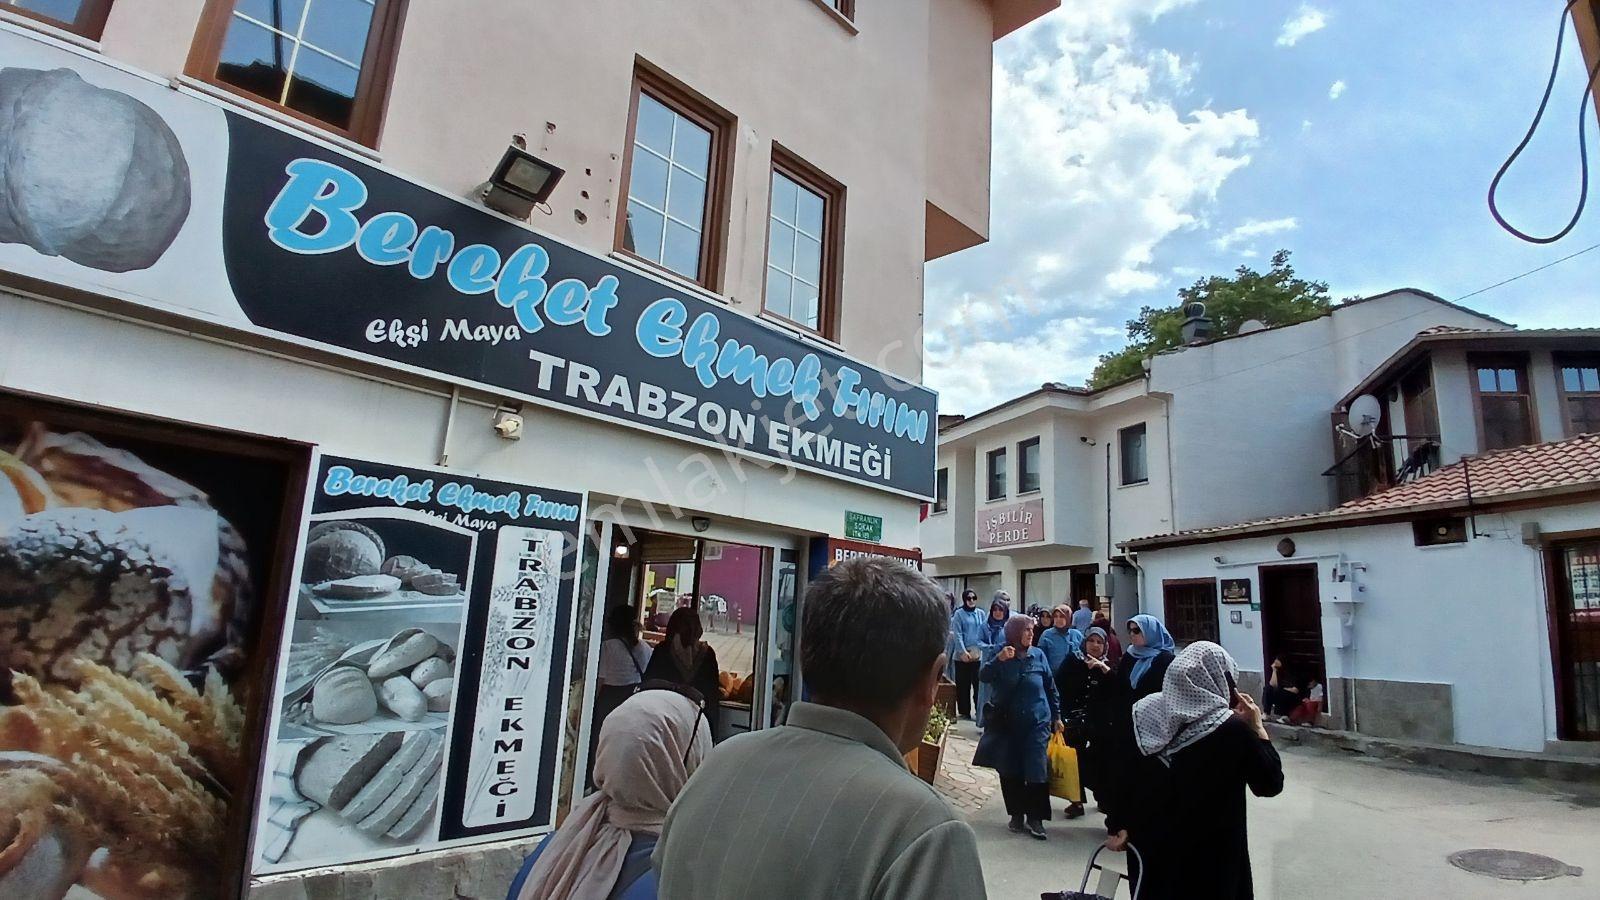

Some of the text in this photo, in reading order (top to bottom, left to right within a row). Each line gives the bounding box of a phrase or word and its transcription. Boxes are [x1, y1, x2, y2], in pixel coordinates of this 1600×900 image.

[264, 157, 619, 337] Bereket
[636, 297, 823, 421] Ekmek
[365, 318, 522, 348] Ekşi Maya
[529, 349, 894, 481] TRABZON EKMEĞİ
[323, 465, 433, 506] Bereket
[437, 482, 521, 518] Ekmek
[452, 513, 497, 531] Maya
[989, 528, 1029, 544] PERDE
[835, 548, 885, 563] BERE
[488, 538, 544, 818] TRABZON EKMEĞİ
